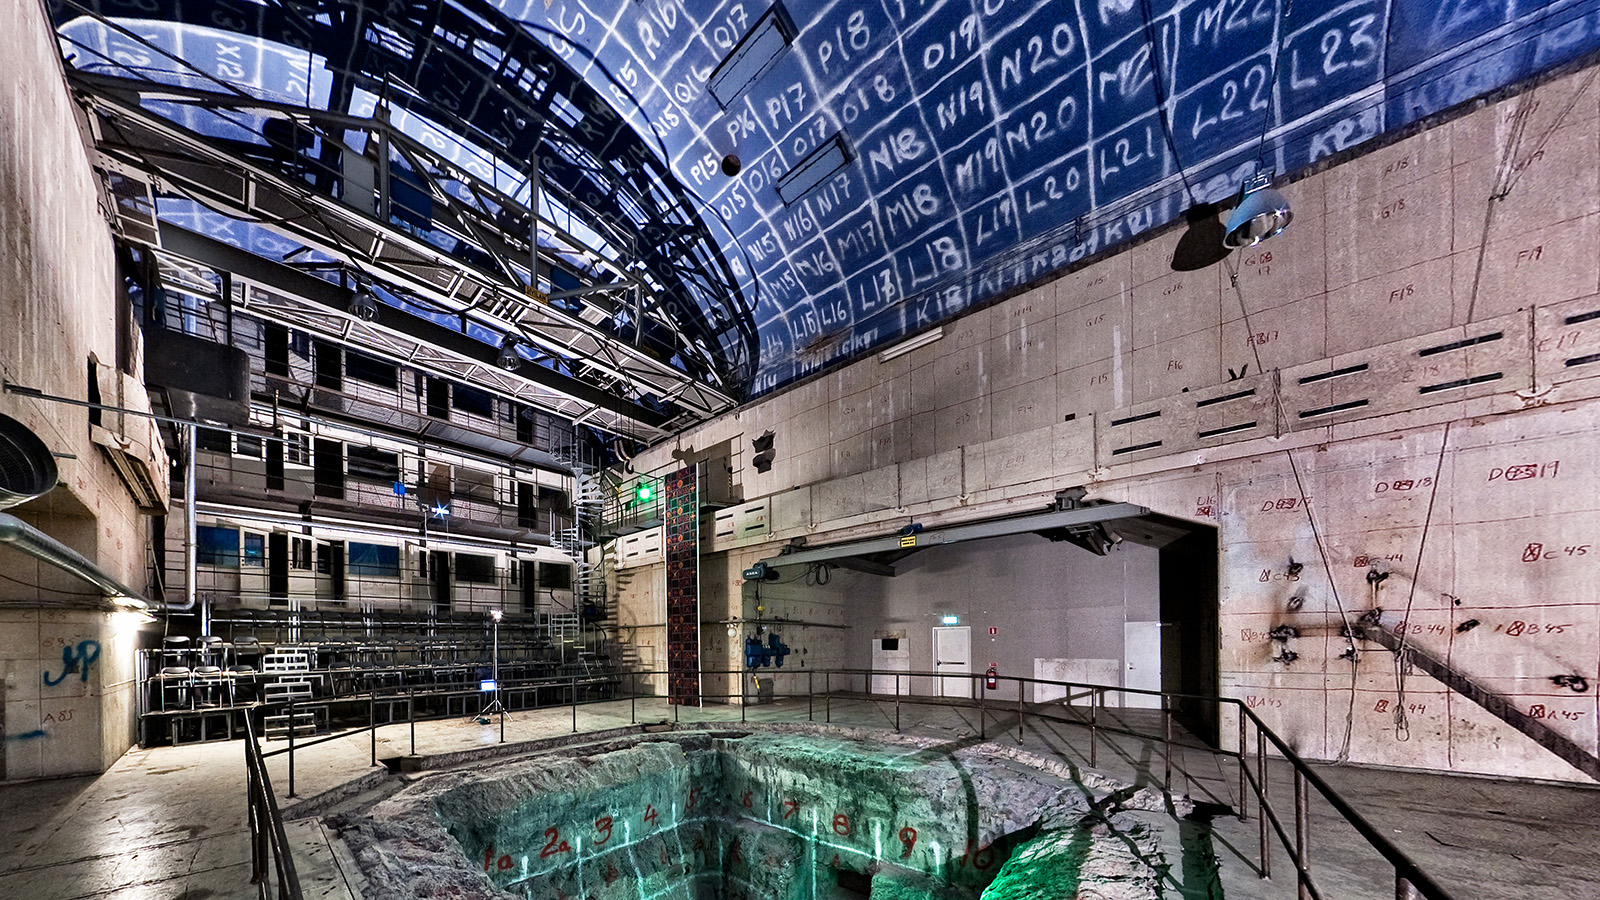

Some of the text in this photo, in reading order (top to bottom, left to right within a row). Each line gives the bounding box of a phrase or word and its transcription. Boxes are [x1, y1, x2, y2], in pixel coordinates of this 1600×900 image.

[714, 4, 748, 50] Q17
[818, 10, 870, 73] P18
[1291, 14, 1377, 90] L23
[216, 42, 245, 79] X12
[1001, 23, 1075, 89] N20
[609, 60, 638, 106] R15
[675, 64, 713, 103] Q16
[766, 82, 806, 130] P17
[937, 81, 985, 130] N19
[1193, 65, 1270, 139] L22
[1006, 96, 1075, 157] M20
[1101, 126, 1156, 183] L21
[690, 153, 719, 185] P15
[817, 173, 851, 216] N17
[1026, 167, 1080, 213] L20
[885, 184, 937, 235] M18
[977, 198, 1012, 246] L19
[1381, 198, 1406, 220] G18
[837, 220, 876, 260] M17
[908, 237, 963, 288] L18
[1258, 266, 1271, 276] 17
[770, 269, 795, 299] M15
[1163, 283, 1184, 297] G16
[1389, 284, 1415, 304] F18
[822, 301, 847, 326] L16
[1085, 313, 1106, 328] G15
[1089, 372, 1108, 387] F15
[1167, 360, 1184, 371] F16
[1018, 404, 1033, 414] F14
[1375, 482, 1389, 493] D
[1415, 477, 1432, 488] 18
[1488, 468, 1503, 481] D
[1540, 461, 1560, 478] 19
[1261, 501, 1274, 512] D
[1384, 554, 1403, 562] 44
[1564, 545, 1592, 556] 45
[1427, 625, 1447, 635] 44
[1545, 624, 1573, 634] 45
[1408, 704, 1426, 714] 44
[1562, 711, 1586, 720] 45
[686, 786, 702, 810] 5
[741, 788, 753, 808] 6
[783, 800, 801, 820] 7
[643, 804, 658, 827] 4
[832, 814, 850, 836] 8
[540, 827, 572, 859] 2a
[594, 816, 613, 846] 3
[898, 826, 918, 859] 9
[483, 846, 515, 872] 1a
[961, 838, 995, 870] 10
